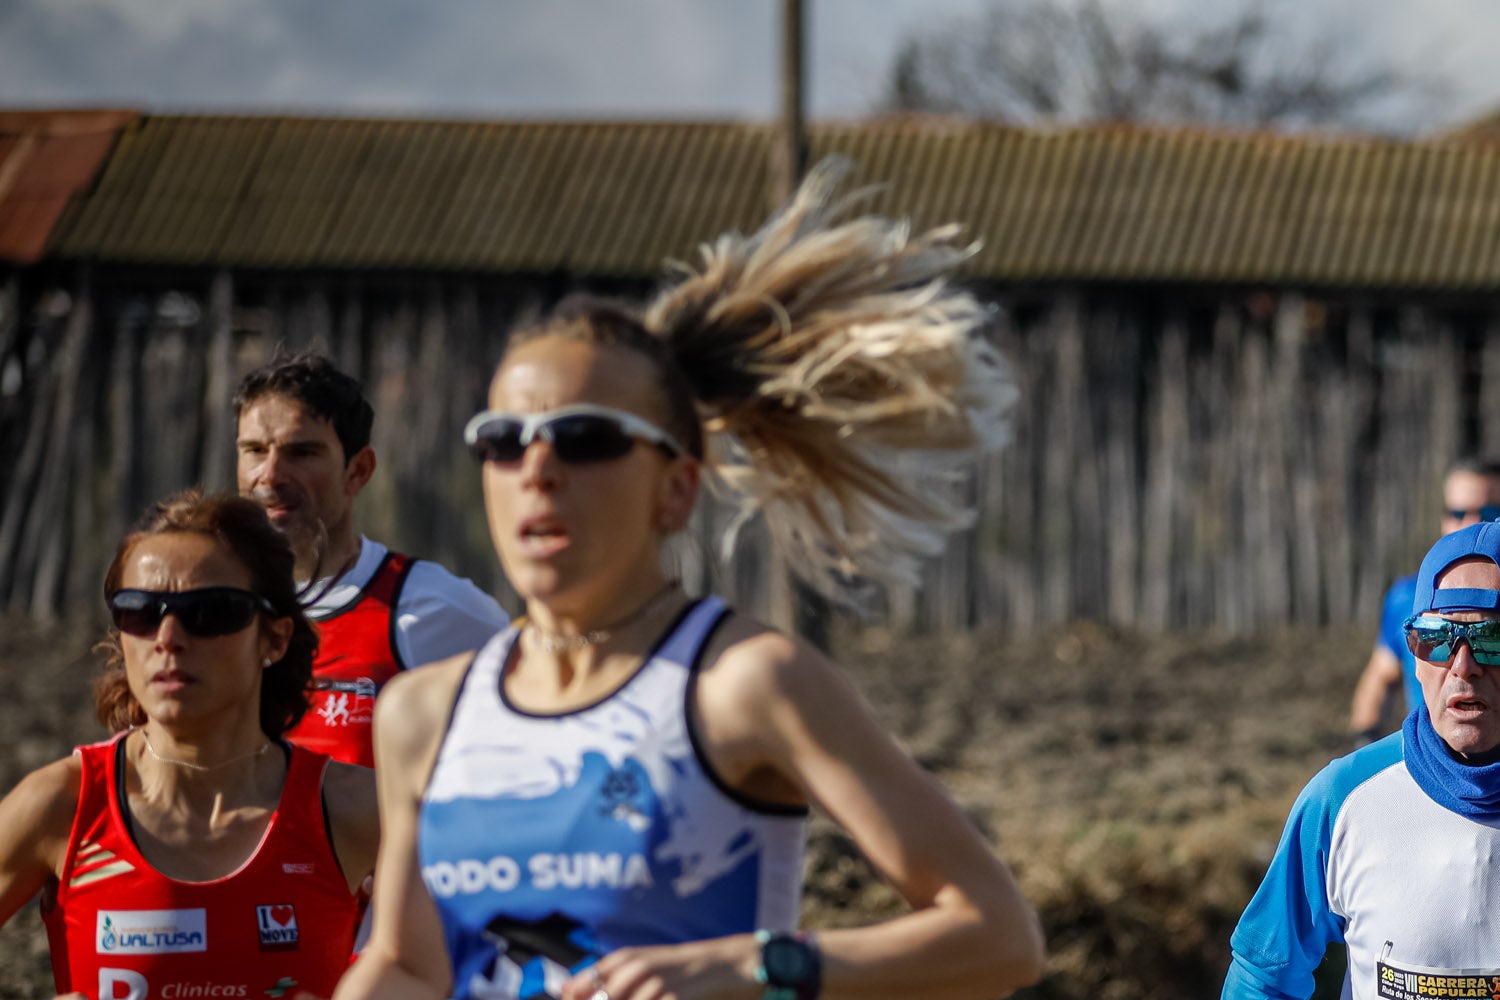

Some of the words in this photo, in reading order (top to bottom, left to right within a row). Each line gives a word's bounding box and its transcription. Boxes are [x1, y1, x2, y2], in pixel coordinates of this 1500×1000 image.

[527, 853, 656, 890] SUMA
[260, 928, 298, 943] MOVE
[1381, 966, 1394, 982] 26
[161, 981, 248, 998] Clínicas
[1404, 973, 1418, 993] VII
[1417, 975, 1488, 989] CARRERA
[1382, 985, 1395, 996] Ruta
[1395, 991, 1404, 999] de
[1418, 986, 1488, 997] POPULAR
